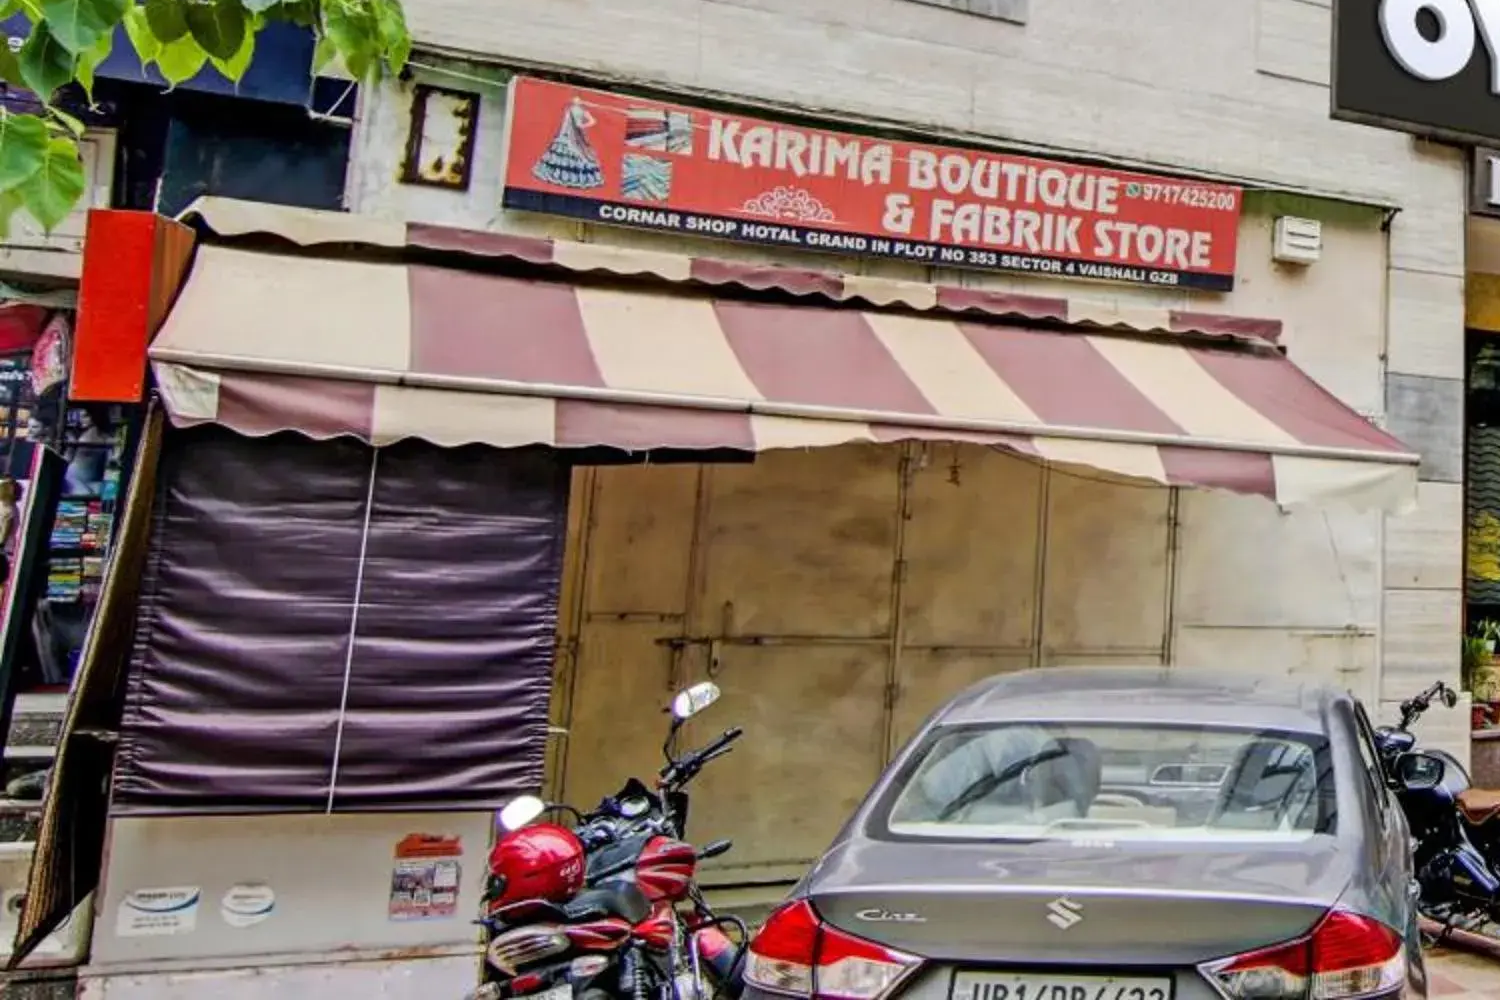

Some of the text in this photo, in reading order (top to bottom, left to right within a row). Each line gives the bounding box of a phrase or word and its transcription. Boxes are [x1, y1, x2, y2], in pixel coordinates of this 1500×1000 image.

[708, 118, 1120, 214] KARIMA BOUTIQUE
[1143, 183, 1235, 211] 9717425200
[599, 204, 1179, 285] CORNAR SHOP HOTAL GRAND IN PLOT NO 353 SECTOR 4 VAISHALI GZB
[882, 193, 1212, 269] & FABRIK STORE
